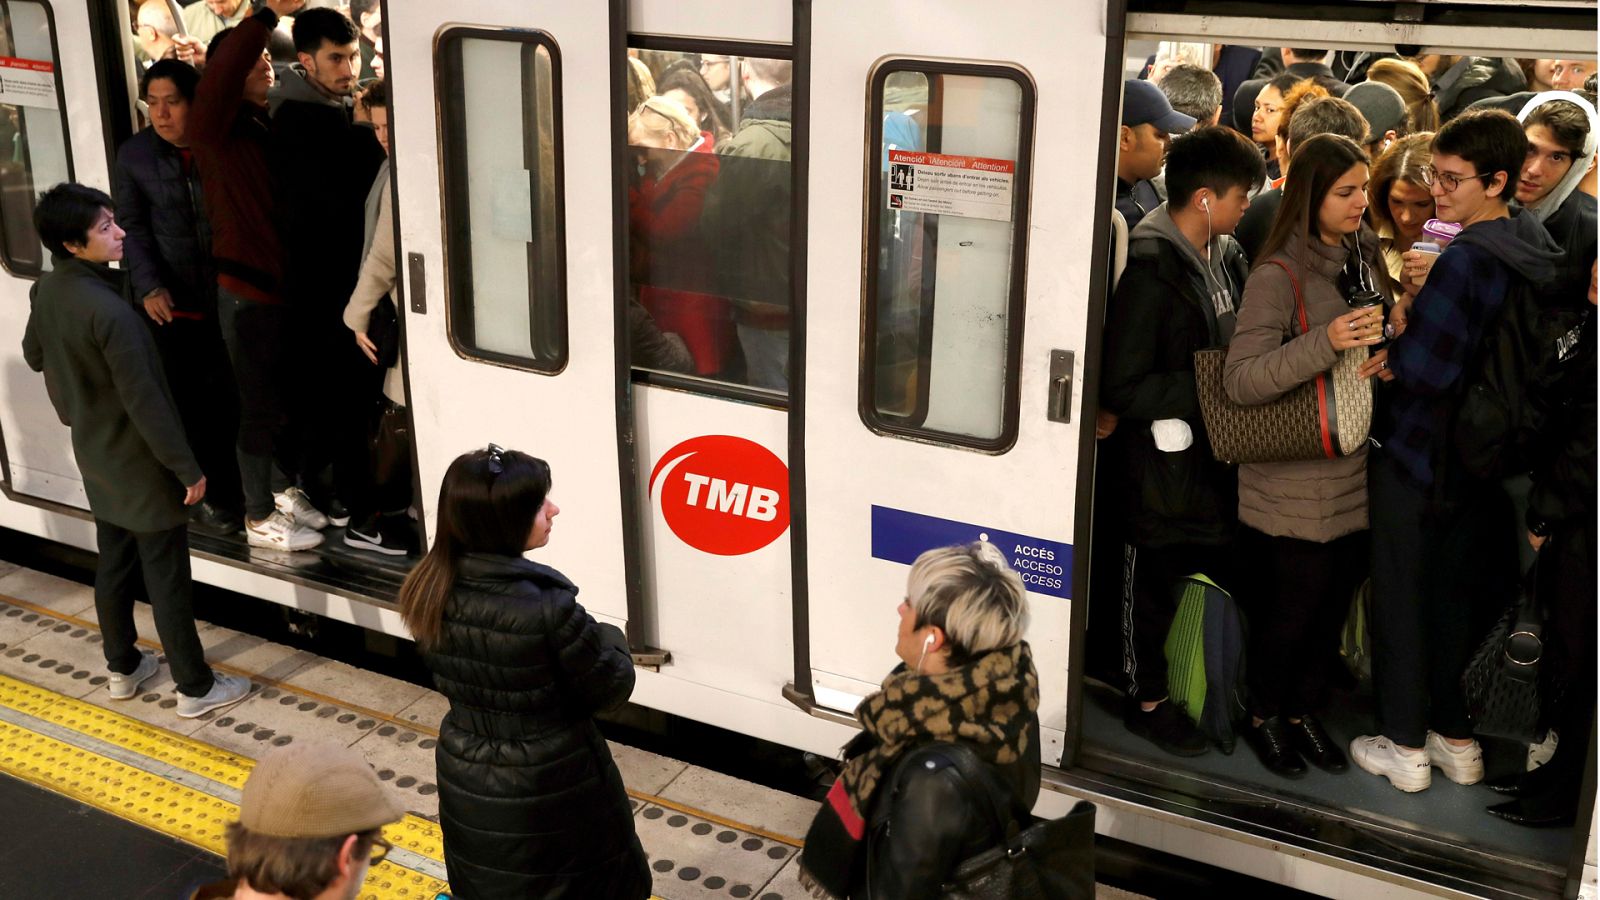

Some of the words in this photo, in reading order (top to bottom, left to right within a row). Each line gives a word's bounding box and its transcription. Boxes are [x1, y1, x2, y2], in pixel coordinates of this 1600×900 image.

[893, 154, 925, 164] Atenció!
[929, 156, 966, 168] ¡Atención!
[971, 161, 1008, 172] Attention!
[684, 472, 780, 522] TMB
[1014, 544, 1055, 561] ACCÉS
[1013, 557, 1063, 576] ACCESO
